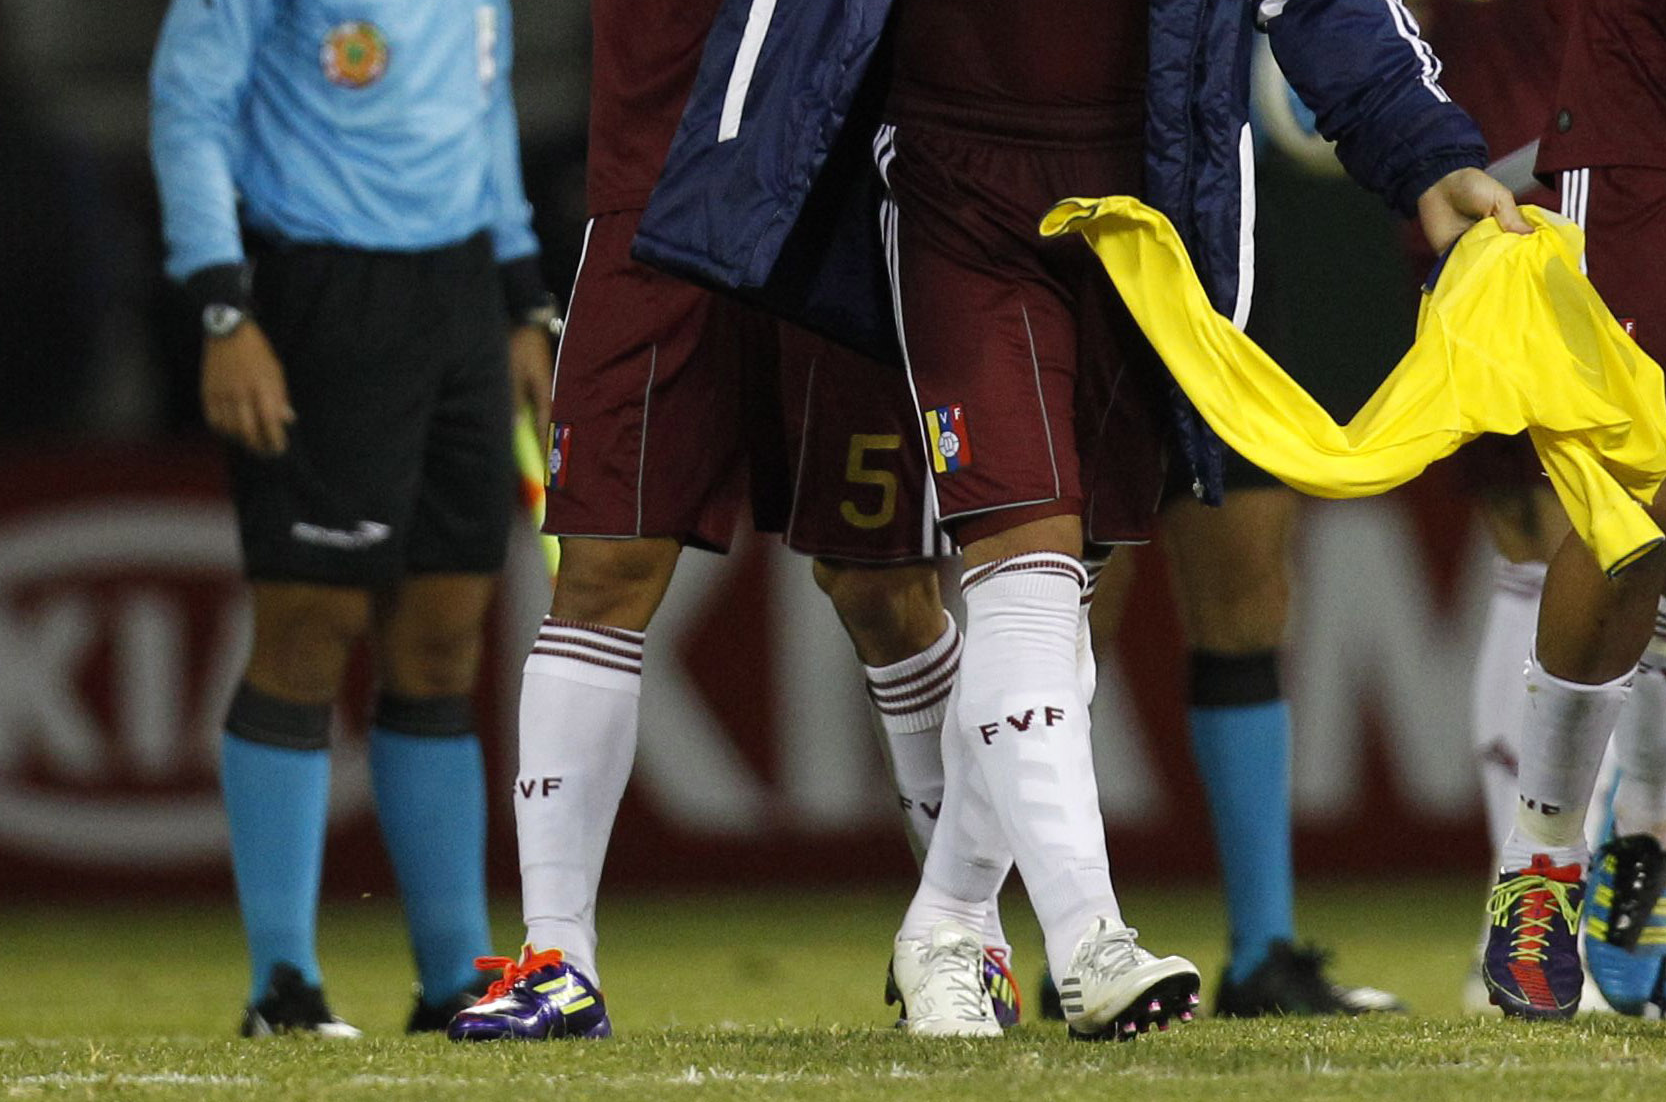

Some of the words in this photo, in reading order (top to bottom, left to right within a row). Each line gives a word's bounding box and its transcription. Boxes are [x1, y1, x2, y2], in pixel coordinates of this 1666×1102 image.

[839, 433, 902, 530] 5
[978, 705, 1066, 746] FVF
[513, 776, 563, 799] VF
[901, 794, 942, 820] FV
